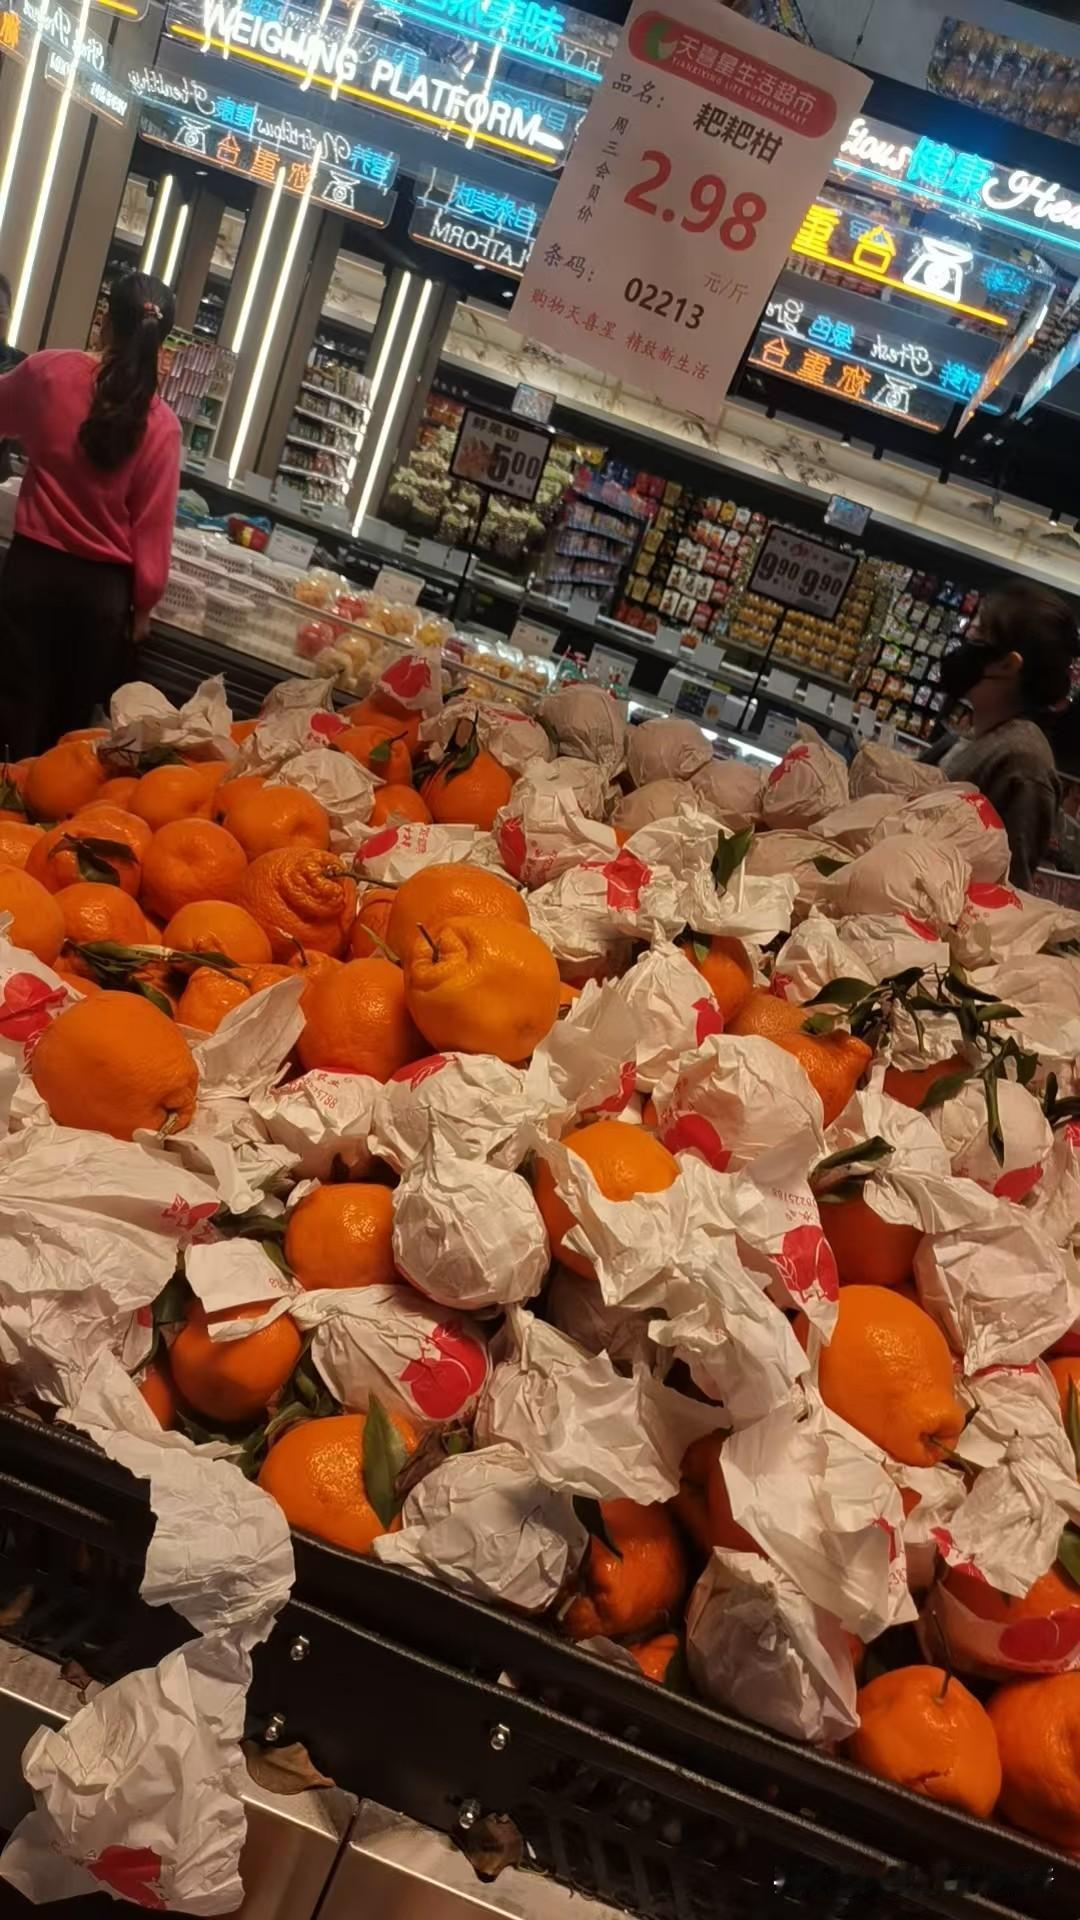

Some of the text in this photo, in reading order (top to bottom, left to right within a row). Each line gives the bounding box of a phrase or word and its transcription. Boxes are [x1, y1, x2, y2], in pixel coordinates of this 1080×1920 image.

[203, 2, 357, 82] WEIGHING
[372, 61, 542, 146] PLATFORM
[676, 33, 817, 115] 天喜星生活超市
[577, 115, 630, 225] 周三会员价
[623, 150, 768, 252] 2.98
[531, 288, 710, 380] 购物天喜星 精致新生活
[623, 277, 706, 329] 02213
[703, 272, 749, 304] 元/斤
